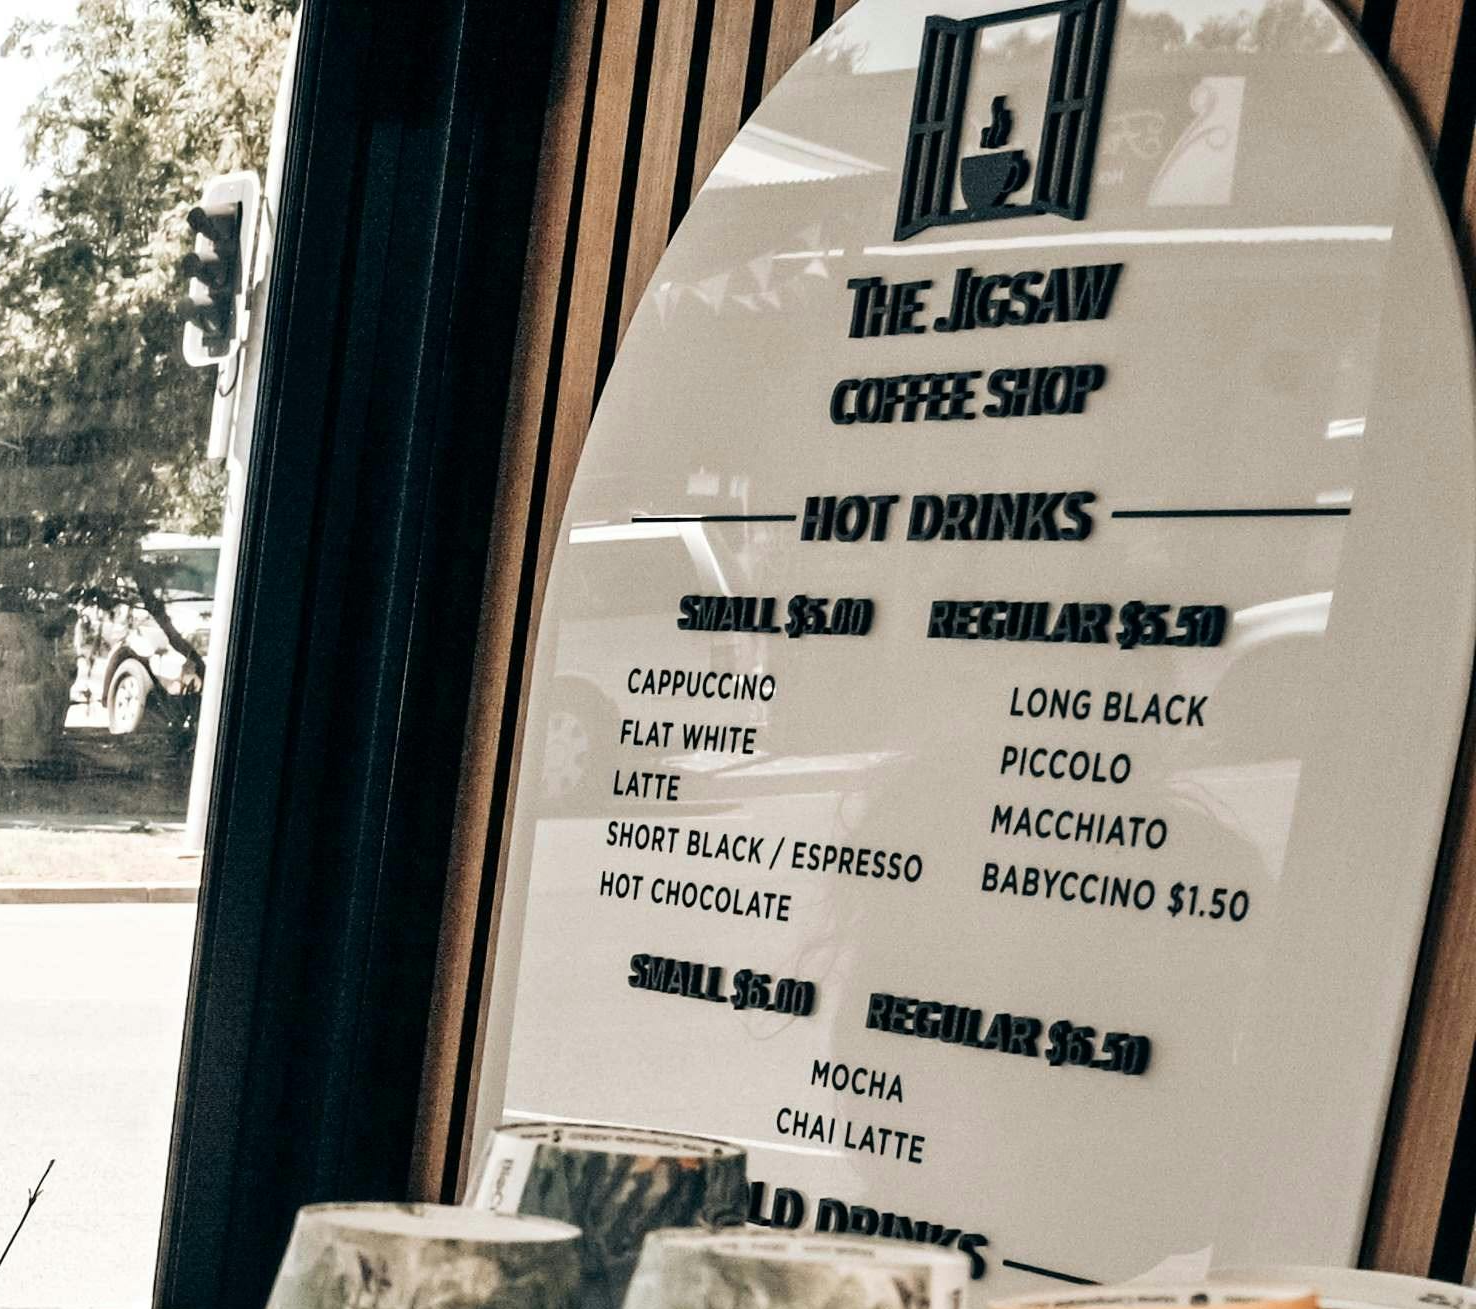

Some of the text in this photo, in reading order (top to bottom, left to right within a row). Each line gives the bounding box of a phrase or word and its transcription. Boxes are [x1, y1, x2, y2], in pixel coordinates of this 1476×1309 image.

[935, 263, 1124, 333] JIGSAW
[829, 364, 1107, 424] COFFEE SHOP
[800, 491, 1096, 541] HOT DRINKS
[677, 594, 875, 638] SMALL $5.00
[927, 600, 1227, 650] REGULAR $5.50
[627, 668, 776, 701] CAPPUCCINO
[1010, 687, 1208, 727] LONG BLACK
[620, 719, 757, 755] FLAT WHITE
[613, 770, 680, 801] LATTE
[1001, 745, 1131, 784] PICCOLO
[606, 821, 923, 883] SHORT BLACK / ESPRESSO
[990, 804, 1167, 850] MACCHIATO
[600, 870, 792, 922] HOT CHOCOLATE
[981, 862, 1250, 922] BABYCCINO $1.50
[628, 953, 815, 1016] SMALL $6.00
[866, 992, 1151, 1076] REGULAR $6.50
[810, 1059, 904, 1104] MOCHA
[776, 1107, 926, 1164] CHAI LATTE
[746, 1180, 804, 1230] LD
